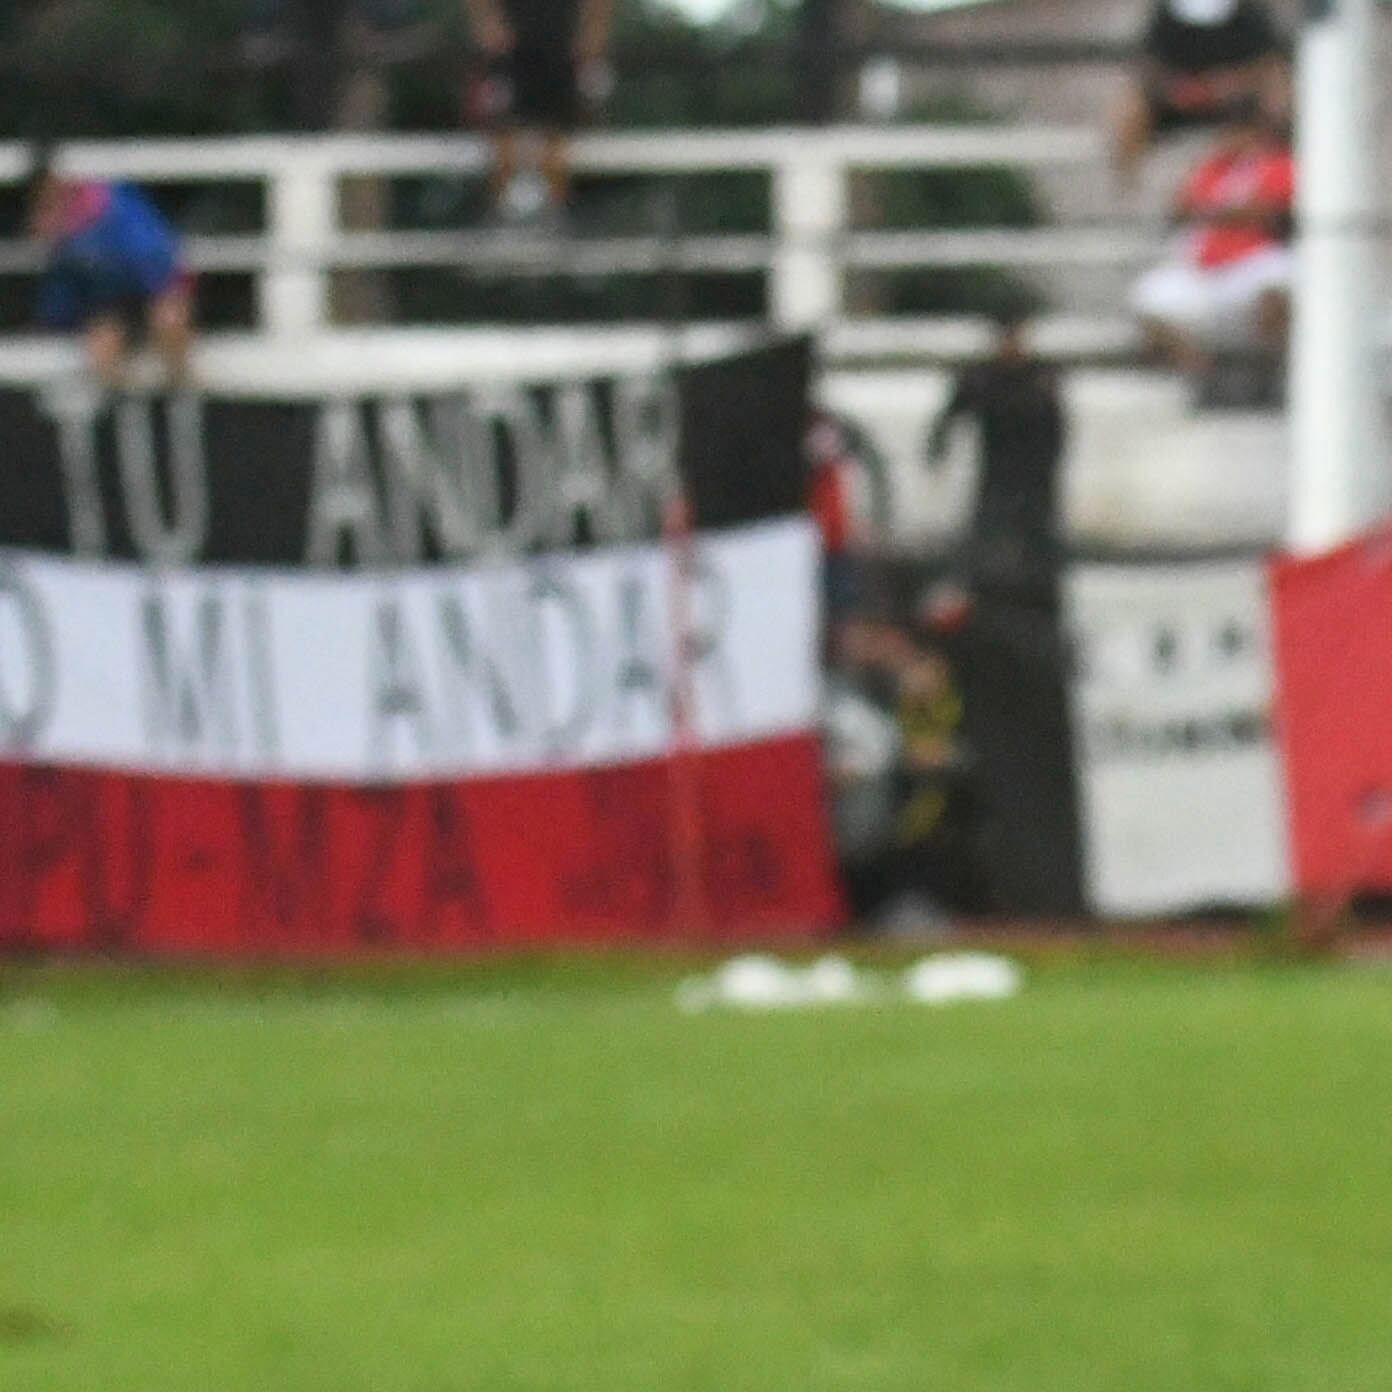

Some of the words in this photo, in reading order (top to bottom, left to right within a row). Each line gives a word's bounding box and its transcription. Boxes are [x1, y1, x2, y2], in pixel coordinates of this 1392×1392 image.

[38, 374, 210, 570] TU
[304, 370, 686, 574] ANDAR
[136, 582, 282, 768] MI
[362, 552, 742, 776] ANDAR
